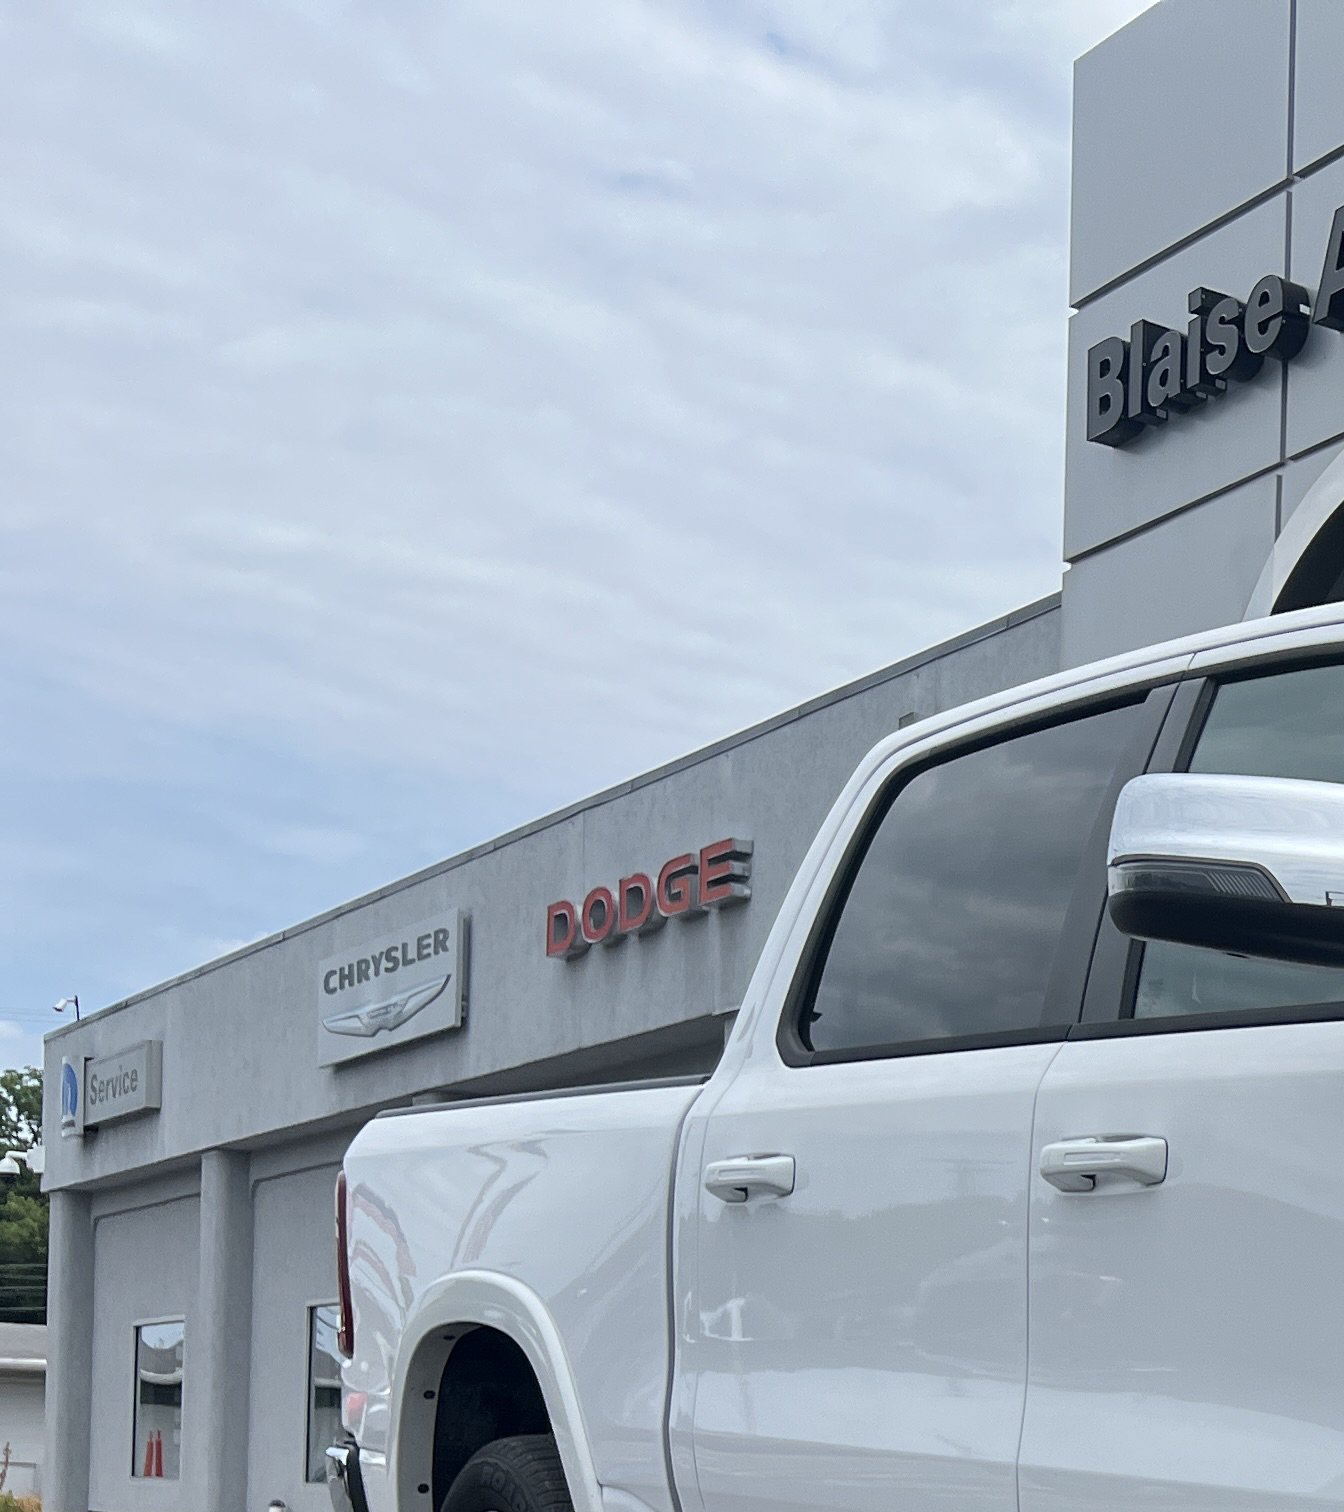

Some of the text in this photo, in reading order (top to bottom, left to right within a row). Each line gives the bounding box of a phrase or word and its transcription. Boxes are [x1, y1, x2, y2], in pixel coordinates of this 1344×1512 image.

[1087, 274, 1303, 445] Blaise
[546, 837, 752, 958] DODGE
[323, 927, 450, 995] CHRYSLER
[89, 1064, 139, 1106] Service
